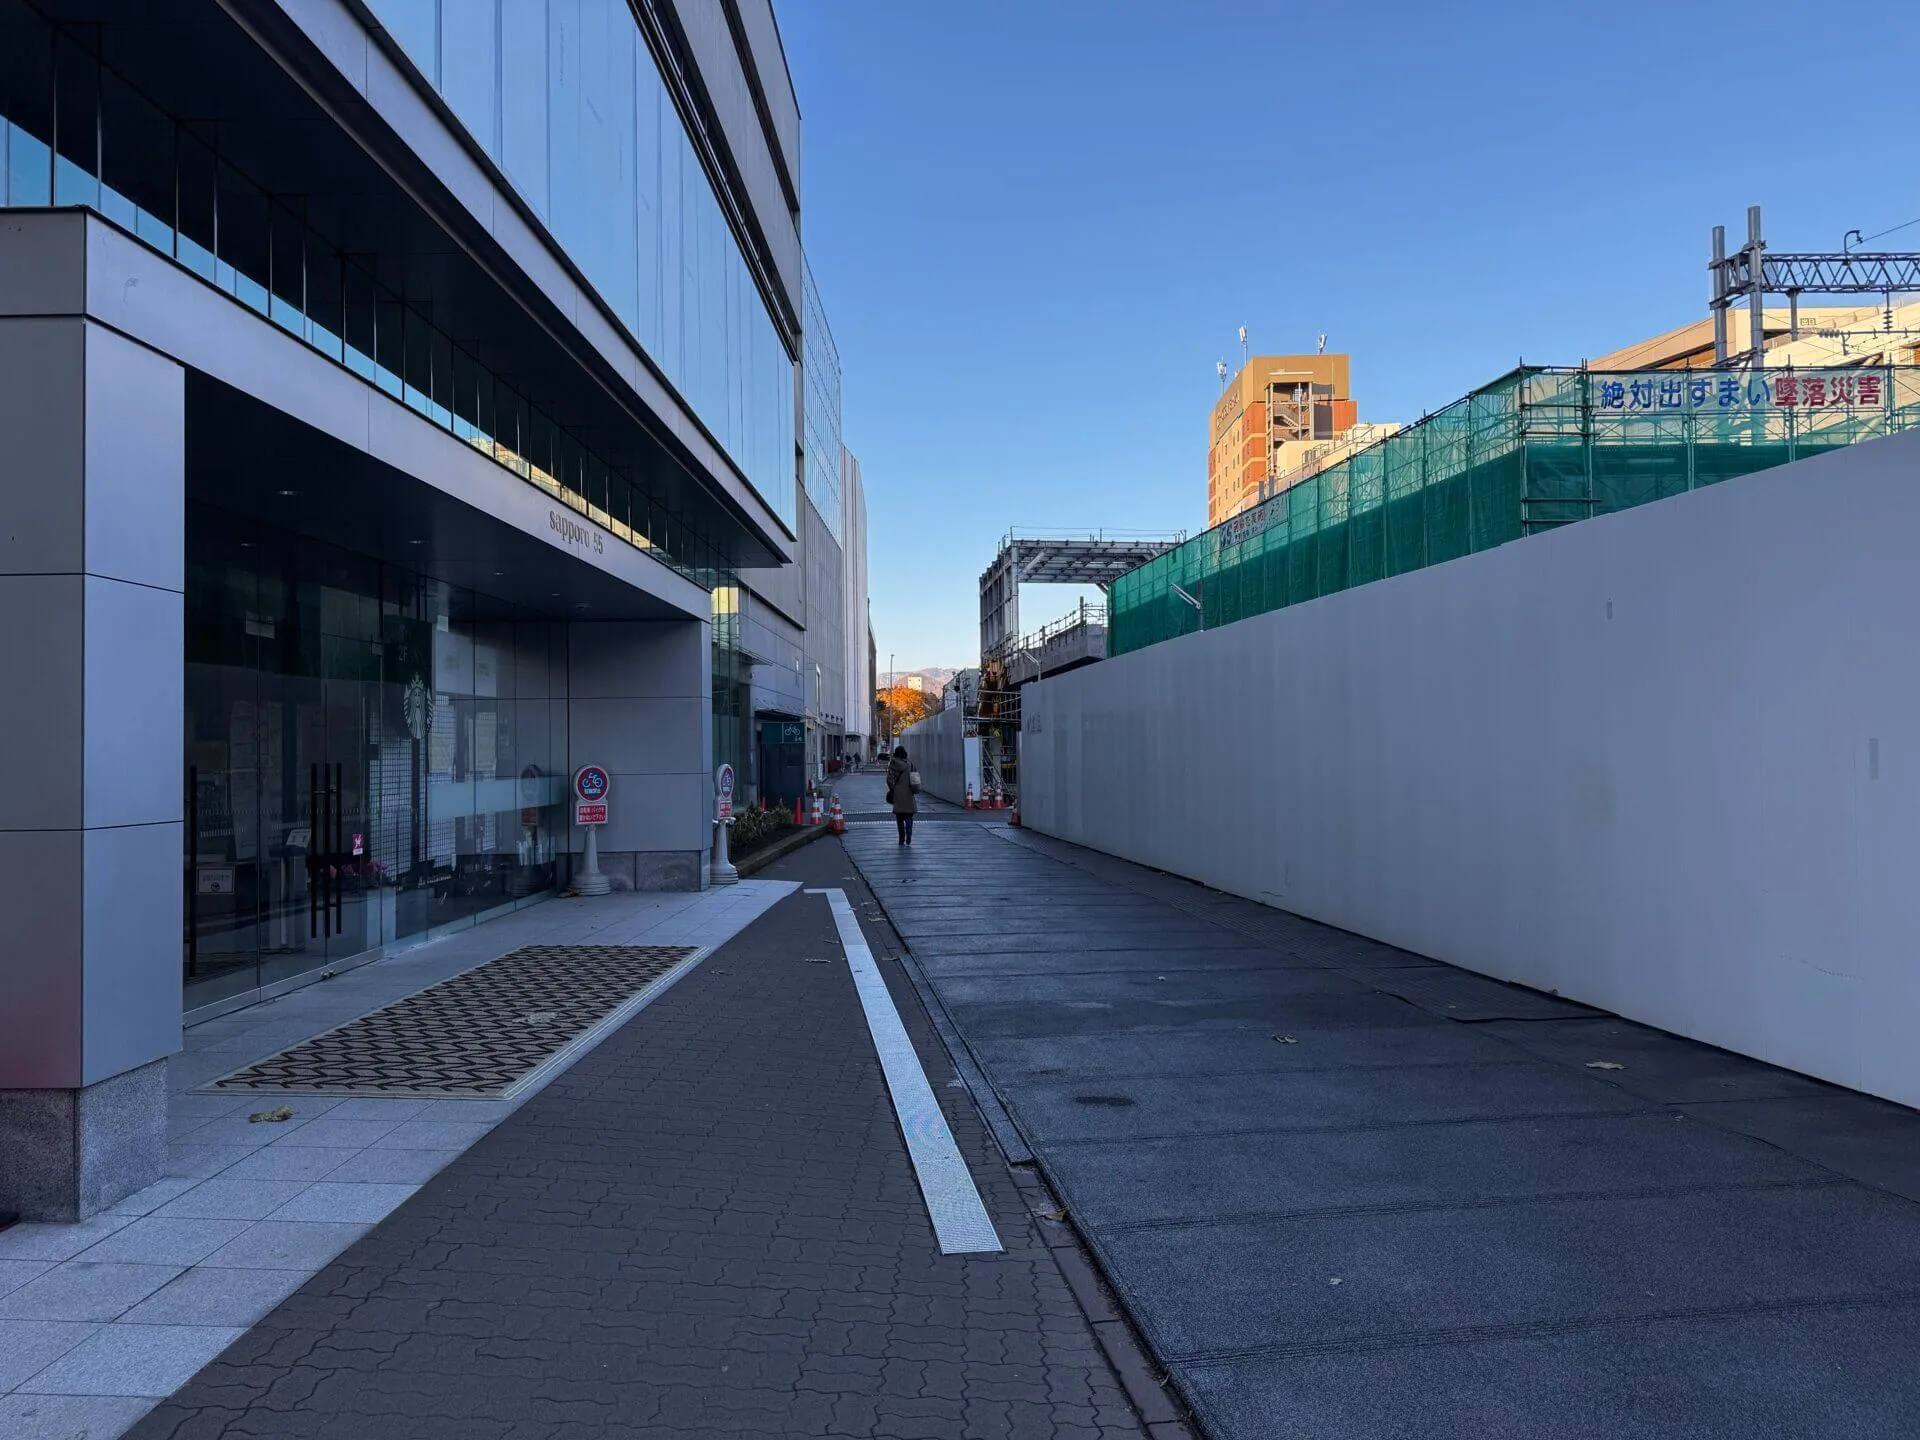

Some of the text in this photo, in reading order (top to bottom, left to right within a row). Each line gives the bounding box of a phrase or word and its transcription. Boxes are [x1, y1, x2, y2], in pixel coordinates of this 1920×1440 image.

[1601, 377, 1881, 409] 絶対出すまい墜落災害
[549, 510, 604, 554] sapporo 55
